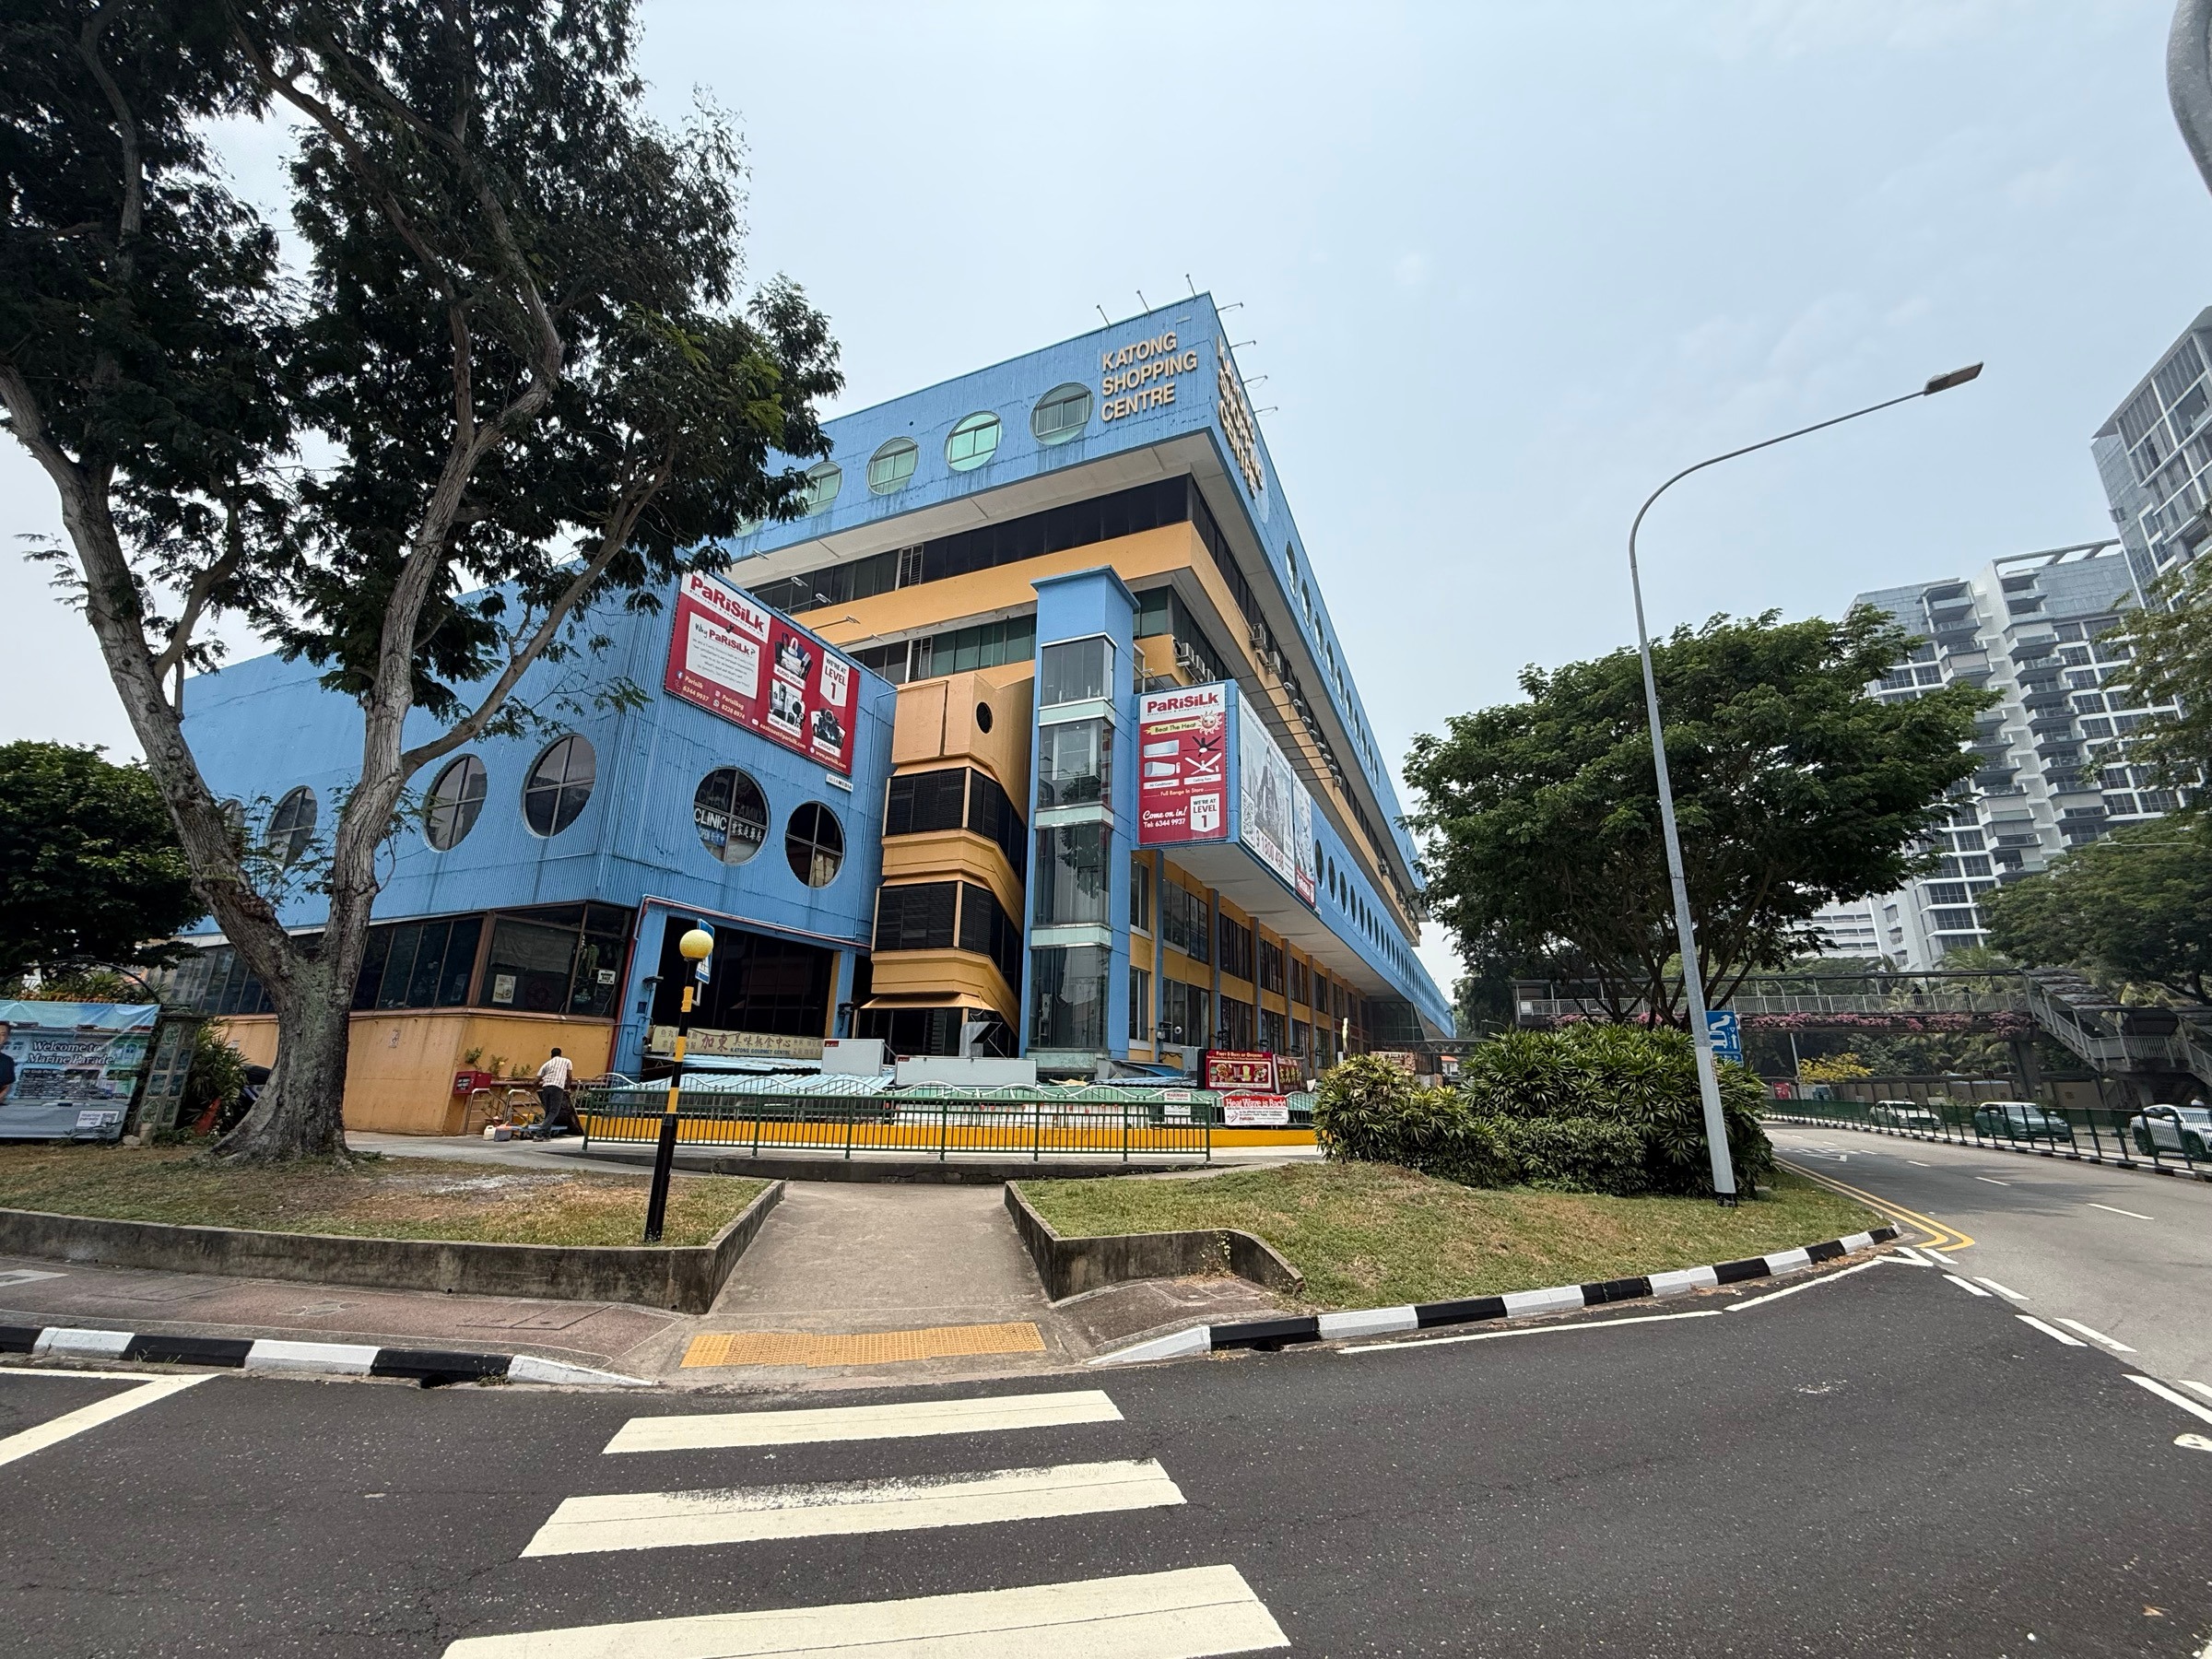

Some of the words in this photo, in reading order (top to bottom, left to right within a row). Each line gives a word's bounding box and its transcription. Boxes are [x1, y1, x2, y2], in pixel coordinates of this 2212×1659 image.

[1102, 331, 1177, 372] KATONG
[1101, 350, 1197, 396] SHOPPING
[1100, 382, 1176, 422] CENTRE
[1218, 368, 1264, 491] SHOPPING
[1218, 399, 1256, 500] CENTRE
[690, 574, 765, 634] PaRiSiLk
[695, 622, 708, 639] Why
[826, 657, 841, 671] WE'RE
[841, 666, 847, 675] AT
[685, 676, 704, 689] Parisilk
[776, 667, 790, 678] AUDIO
[790, 674, 803, 687] VISUAL
[825, 665, 846, 687] LEVEL
[682, 685, 696, 696] 6344
[696, 690, 710, 701] 9937
[830, 682, 837, 700] 1
[1147, 692, 1218, 713] PaRiSiLk
[770, 717, 780, 726] HOME
[818, 741, 836, 754] GADGETS
[1143, 810, 1164, 820] Come
[1175, 806, 1188, 817] in!
[1193, 805, 1217, 814] LEVEL
[693, 807, 727, 831] CLINIC
[1201, 815, 1206, 828] 1
[33, 1041, 89, 1053] Welcome
[89, 1041, 101, 1053] to
[27, 1053, 70, 1065] Marine
[70, 1054, 116, 1065] Parade!
[1226, 1098, 1241, 1107] Heat
[1241, 1098, 1262, 1107] Wave
[1263, 1098, 1268, 1107] is
